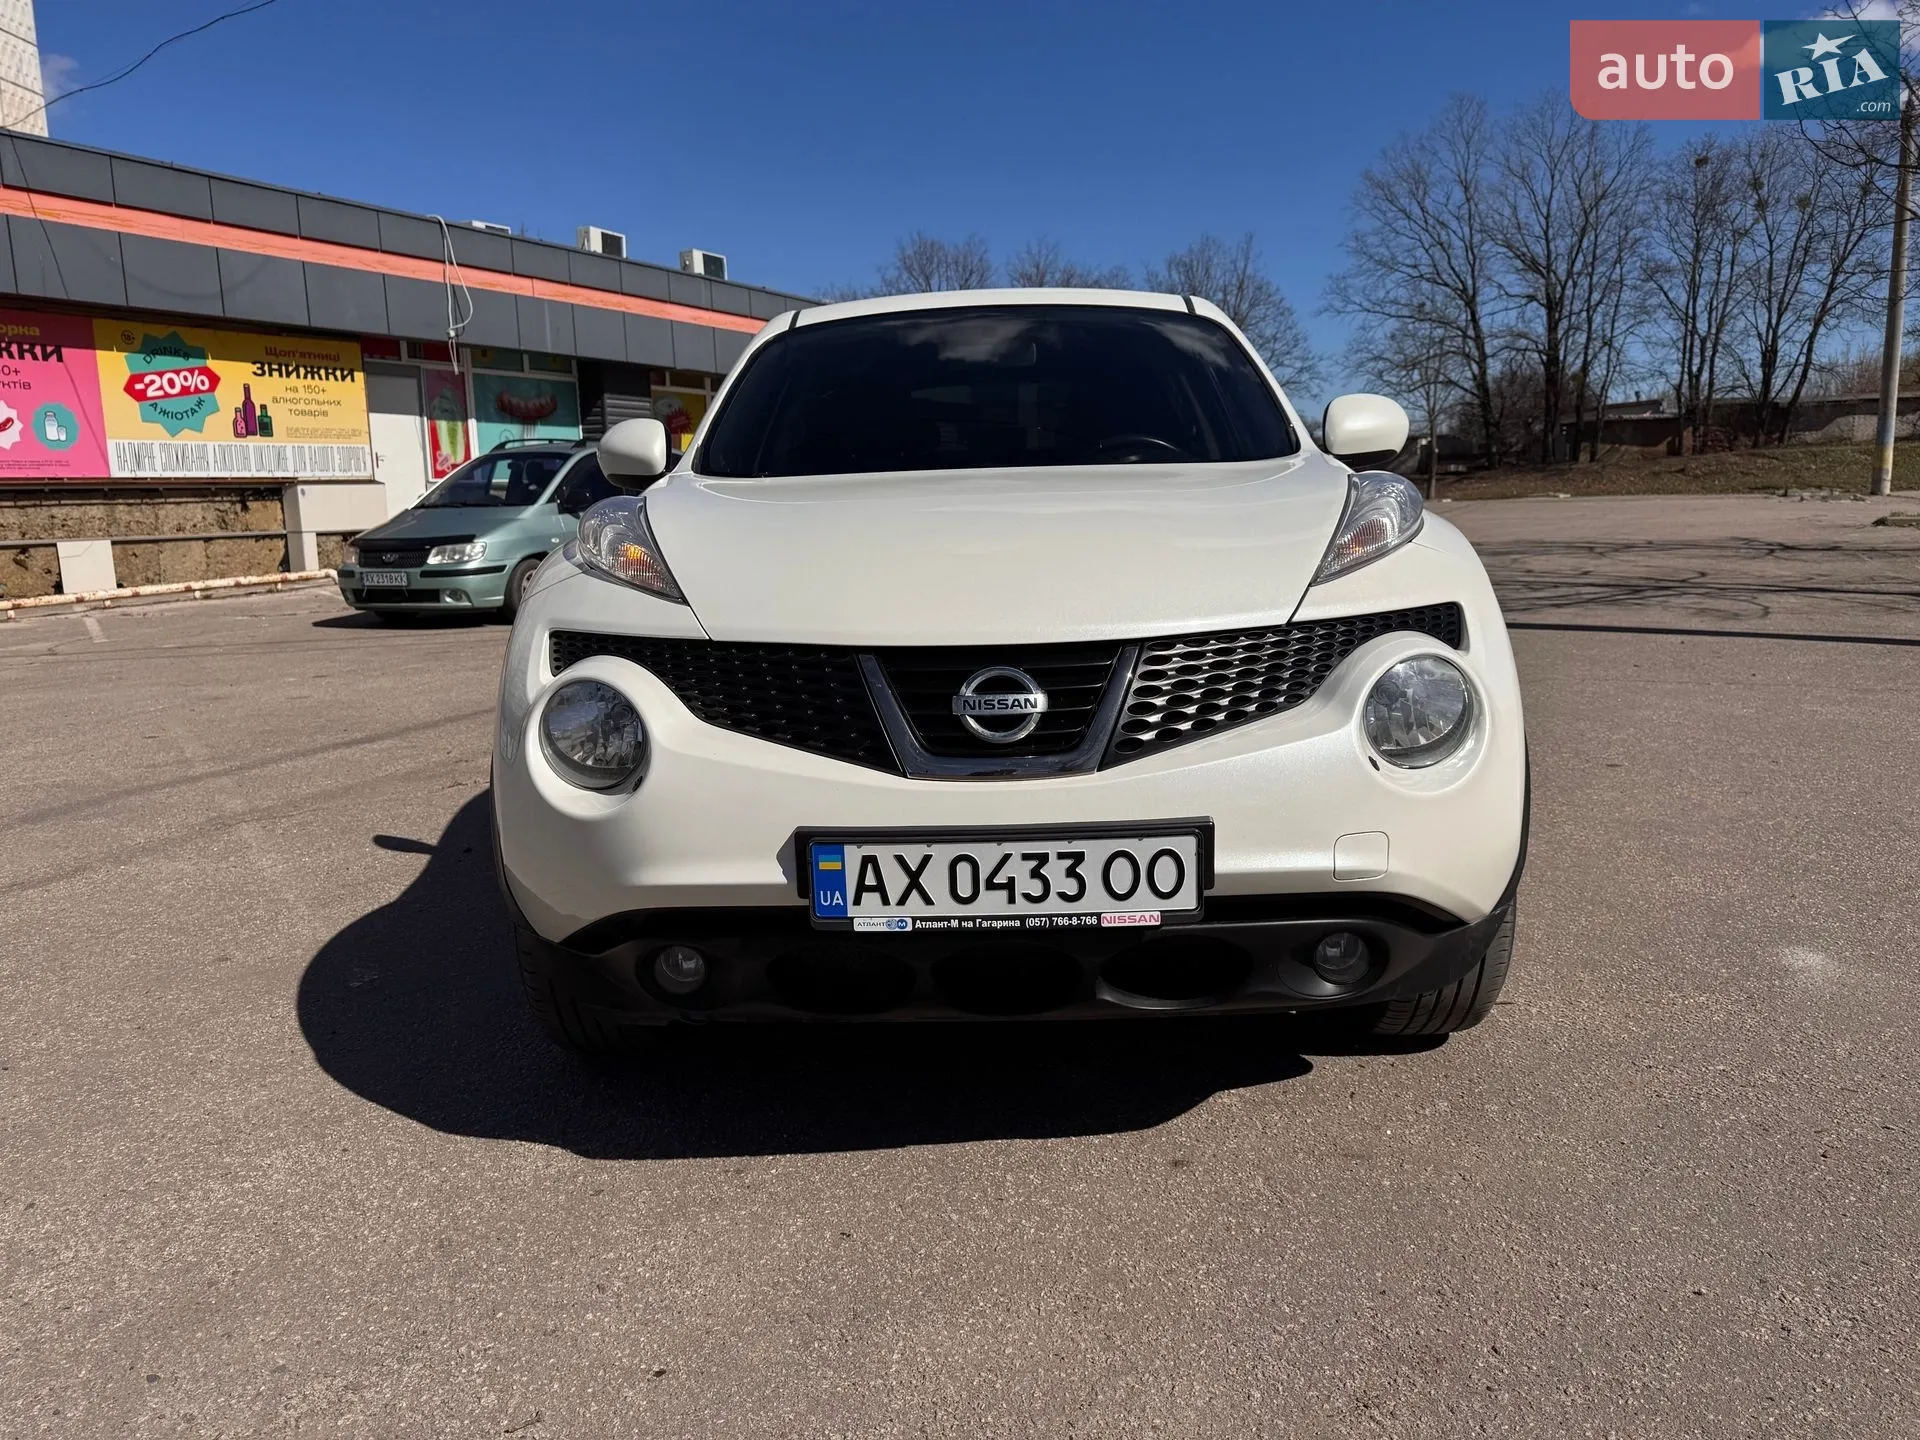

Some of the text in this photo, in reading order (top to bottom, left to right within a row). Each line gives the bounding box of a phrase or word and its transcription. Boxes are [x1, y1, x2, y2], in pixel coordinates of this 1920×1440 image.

[143, 345, 191, 364] DRINKS
[251, 361, 355, 383] ЗНИЖКИ
[0, 380, 32, 390] ктів
[134, 369, 210, 398] -20%
[285, 385, 327, 395] на 150+
[272, 396, 342, 407] алкогольних
[149, 397, 205, 421] АЖІОТАЖ
[288, 408, 329, 418] товарів
[962, 697, 1038, 711] NISSAN
[852, 847, 1186, 907] AX 0433 OO
[820, 890, 844, 906] UA
[915, 916, 1098, 930] Атлант-М на Гагарина (057) 766-8-766
[1101, 914, 1161, 925] NISSAN
